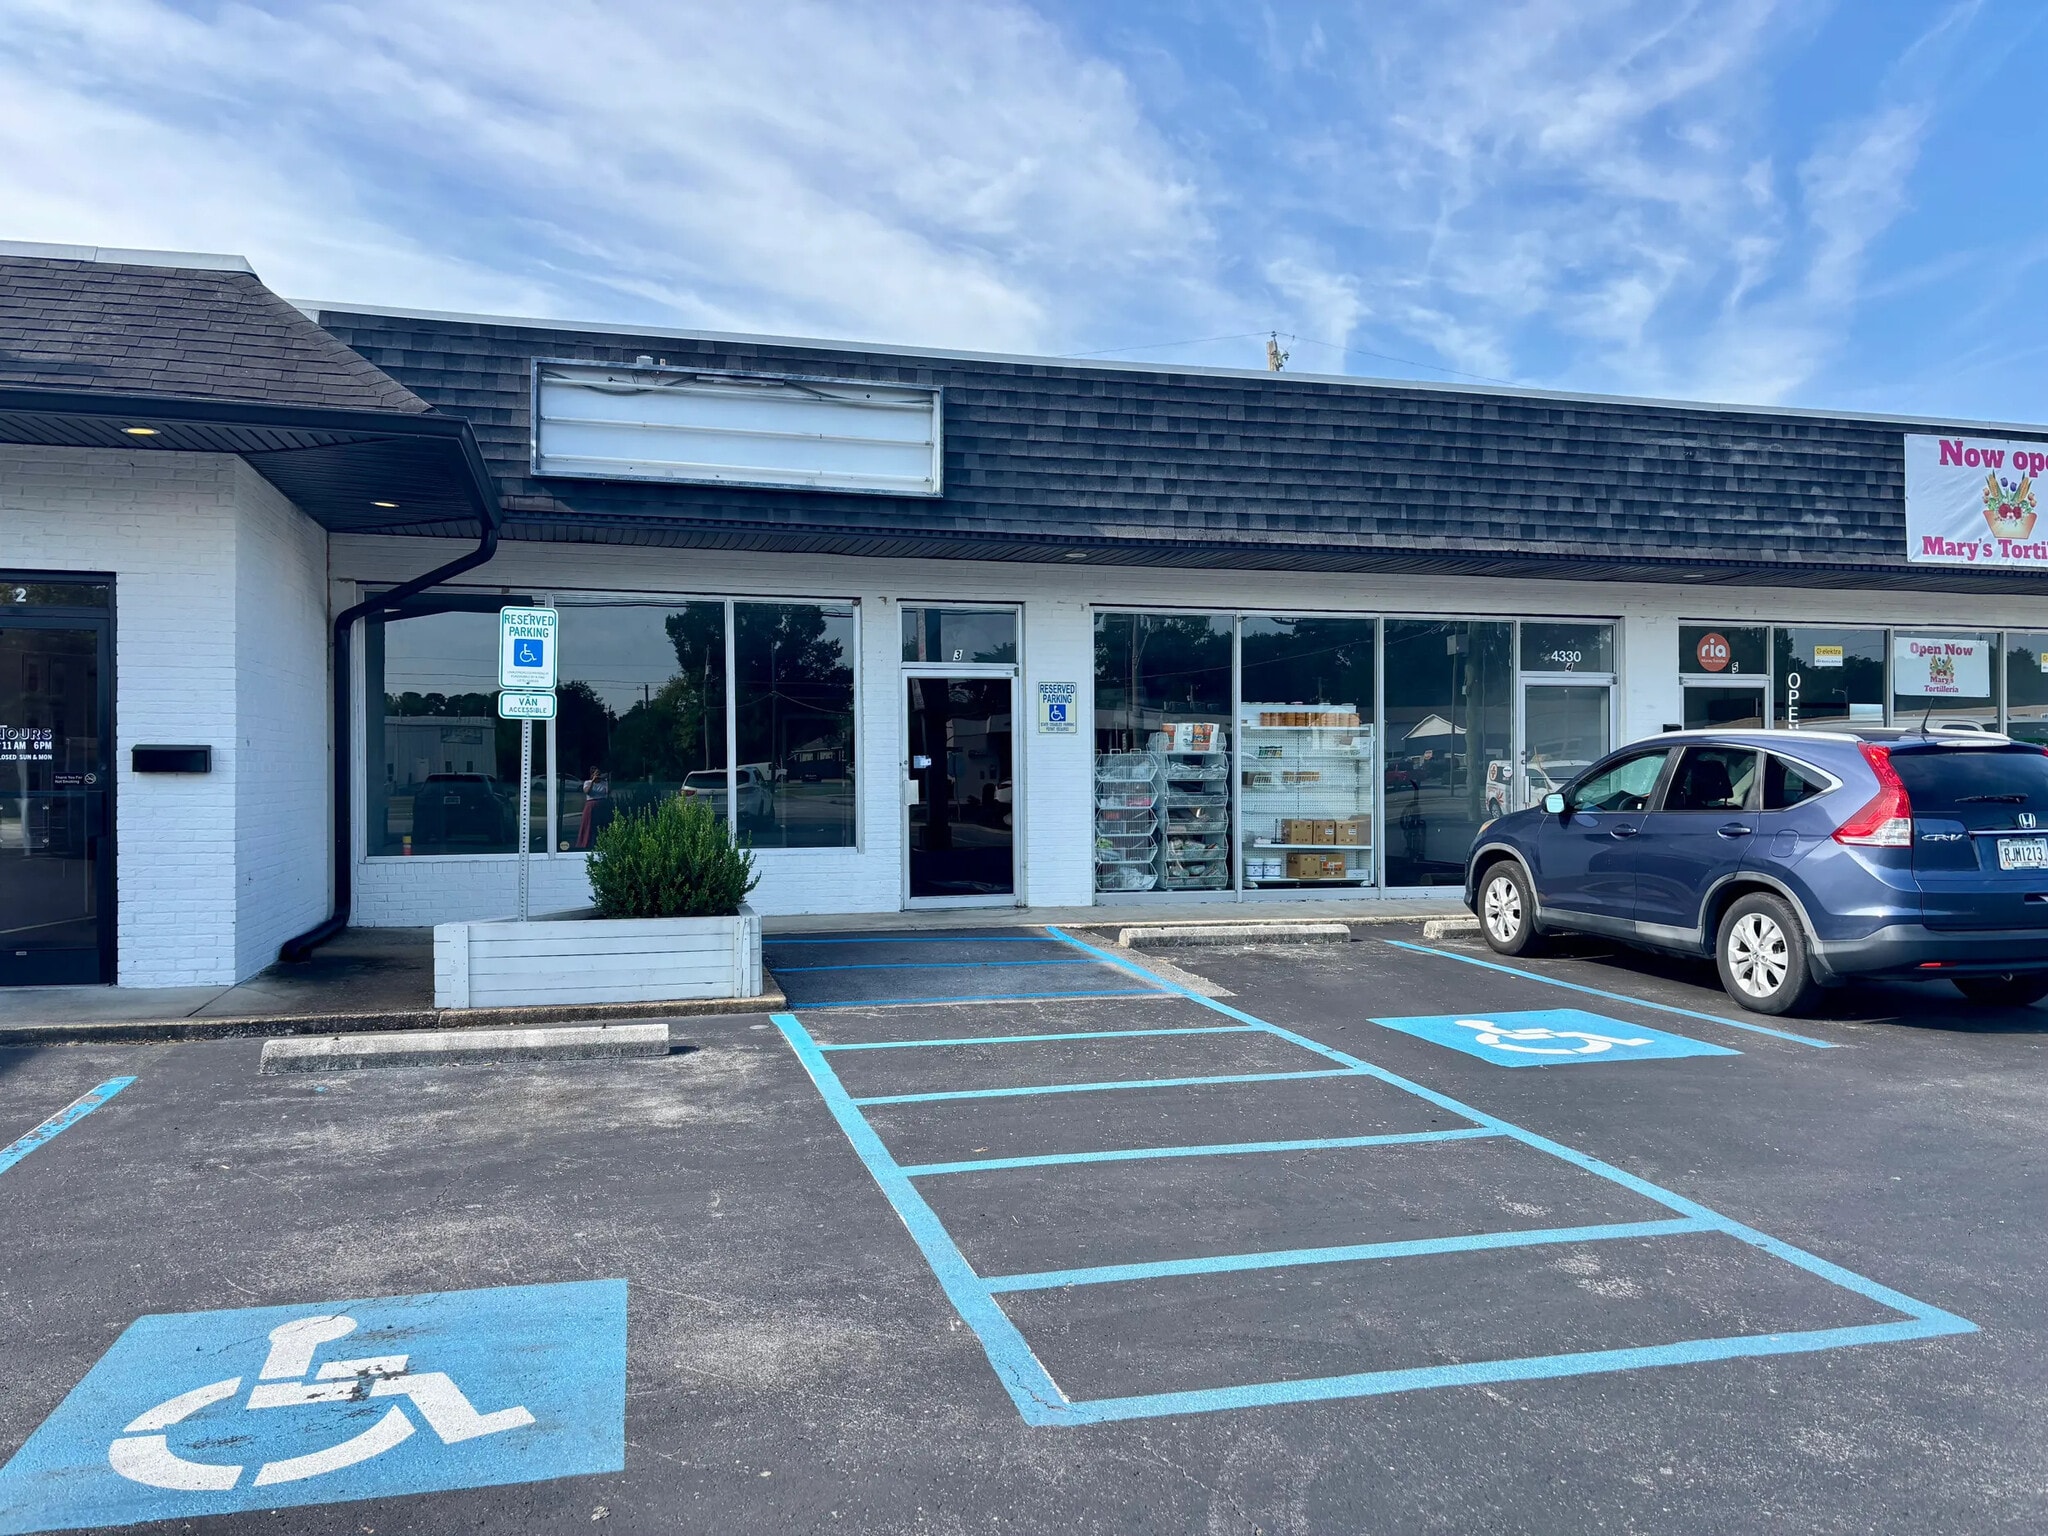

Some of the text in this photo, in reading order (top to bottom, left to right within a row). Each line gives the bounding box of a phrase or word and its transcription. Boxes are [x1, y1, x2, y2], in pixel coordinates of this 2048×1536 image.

[1939, 439, 2048, 478] Now op
[1922, 536, 2048, 561] Mary's Torti
[15, 588, 27, 602] 2
[504, 614, 554, 626] RESERVED
[509, 626, 549, 638] PARKING
[1701, 638, 1726, 657] ria
[1910, 642, 1973, 657] Open Now
[954, 650, 962, 660] 3
[1551, 650, 1581, 662] 4330
[1565, 662, 1573, 671] 4
[1040, 684, 1075, 694] RESERVED
[1924, 685, 1959, 693] Tortilleria
[518, 698, 538, 706] VAN
[1042, 694, 1072, 703] PARKING
[508, 706, 547, 714] ACCESSIBLE
